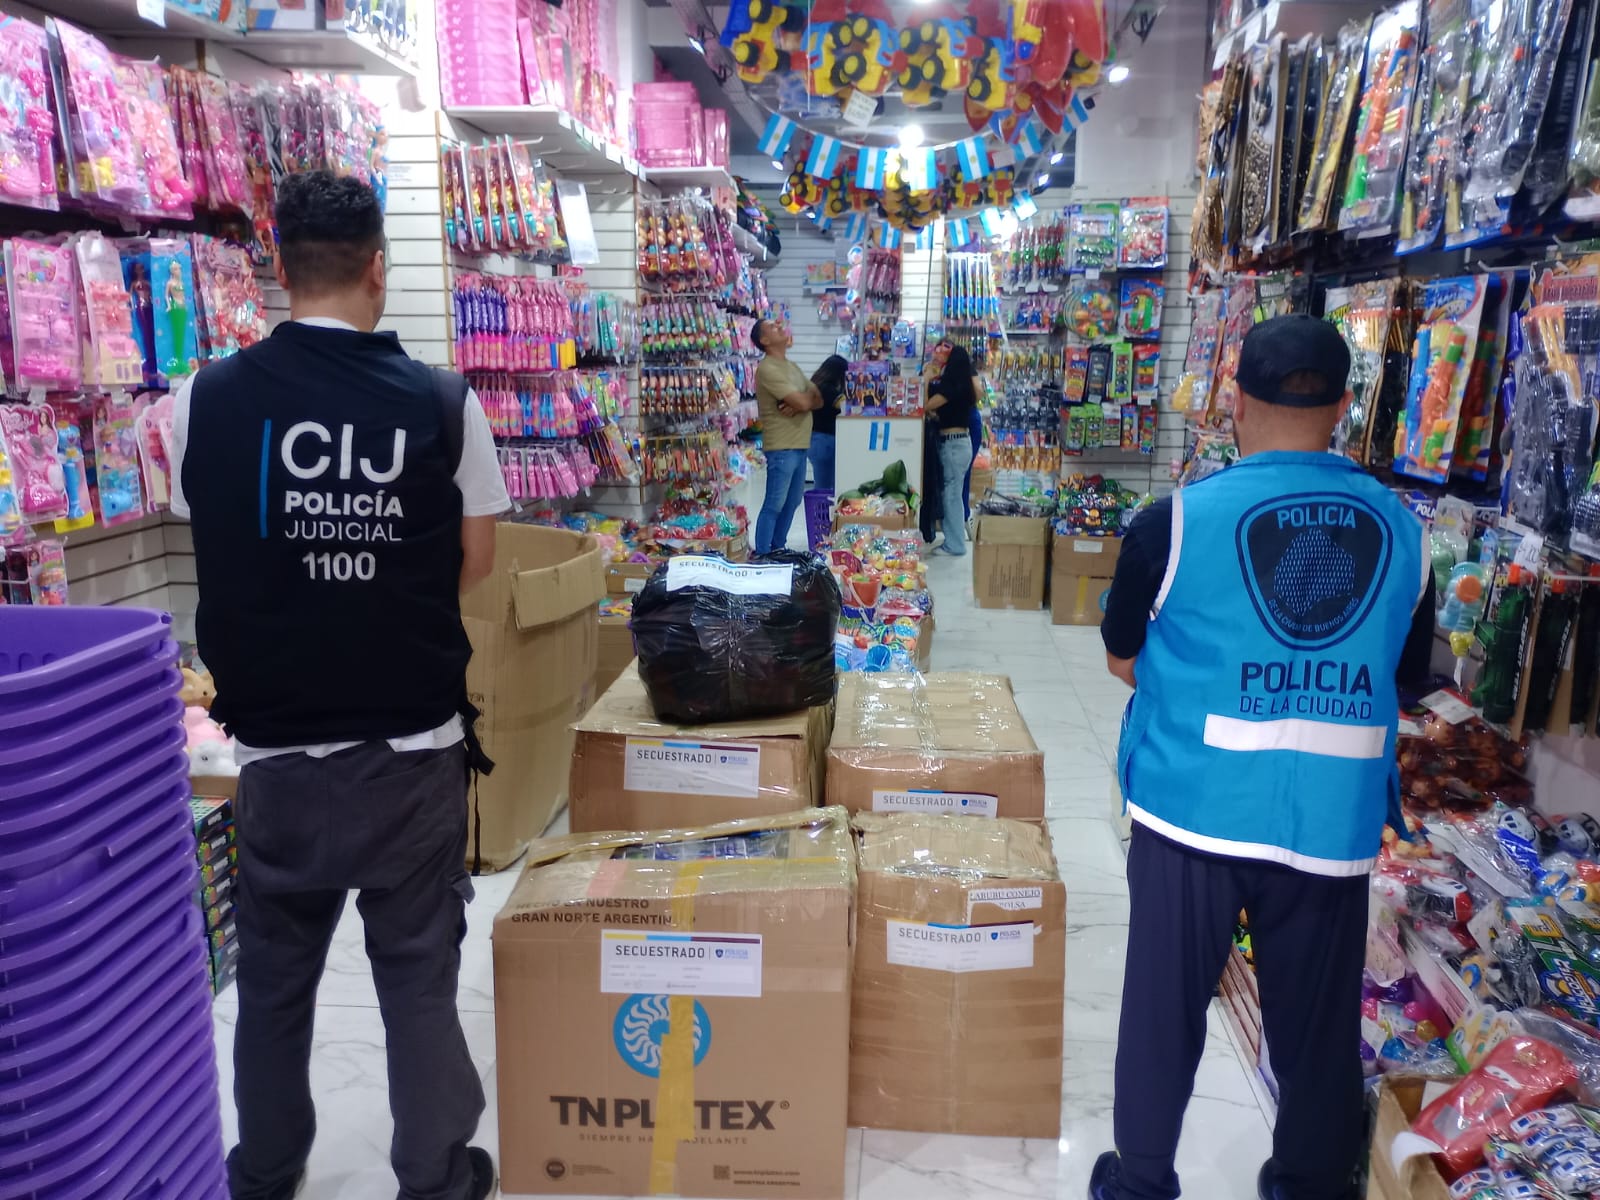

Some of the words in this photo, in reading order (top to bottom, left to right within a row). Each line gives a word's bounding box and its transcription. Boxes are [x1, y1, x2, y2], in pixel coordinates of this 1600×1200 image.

[281, 421, 406, 483] CIJ
[285, 489, 404, 518] POLICÍA
[1276, 505, 1356, 529] POLICIA
[284, 520, 402, 542] JUDICIAL
[302, 551, 376, 581] 1100
[679, 561, 748, 577] SECUESTRADO
[1240, 659, 1373, 697] POLICIA
[1240, 695, 1264, 715] DE
[1270, 696, 1290, 715] LA
[1296, 695, 1372, 720] CIUDAD
[637, 749, 712, 764] SECUESTRADO
[883, 795, 954, 807] SECUESTRADO
[1006, 889, 1041, 900] CONEJO
[586, 898, 649, 909] NUESTRO
[511, 912, 549, 923] GRAN
[554, 912, 600, 923] NORTE
[604, 913, 696, 926] ARGENTIN
[899, 928, 982, 944] SECUESTRADO
[615, 945, 705, 959] SECUESTRADO
[614, 1099, 776, 1130] PLTEX
[579, 1133, 632, 1143] SIEMPRE
